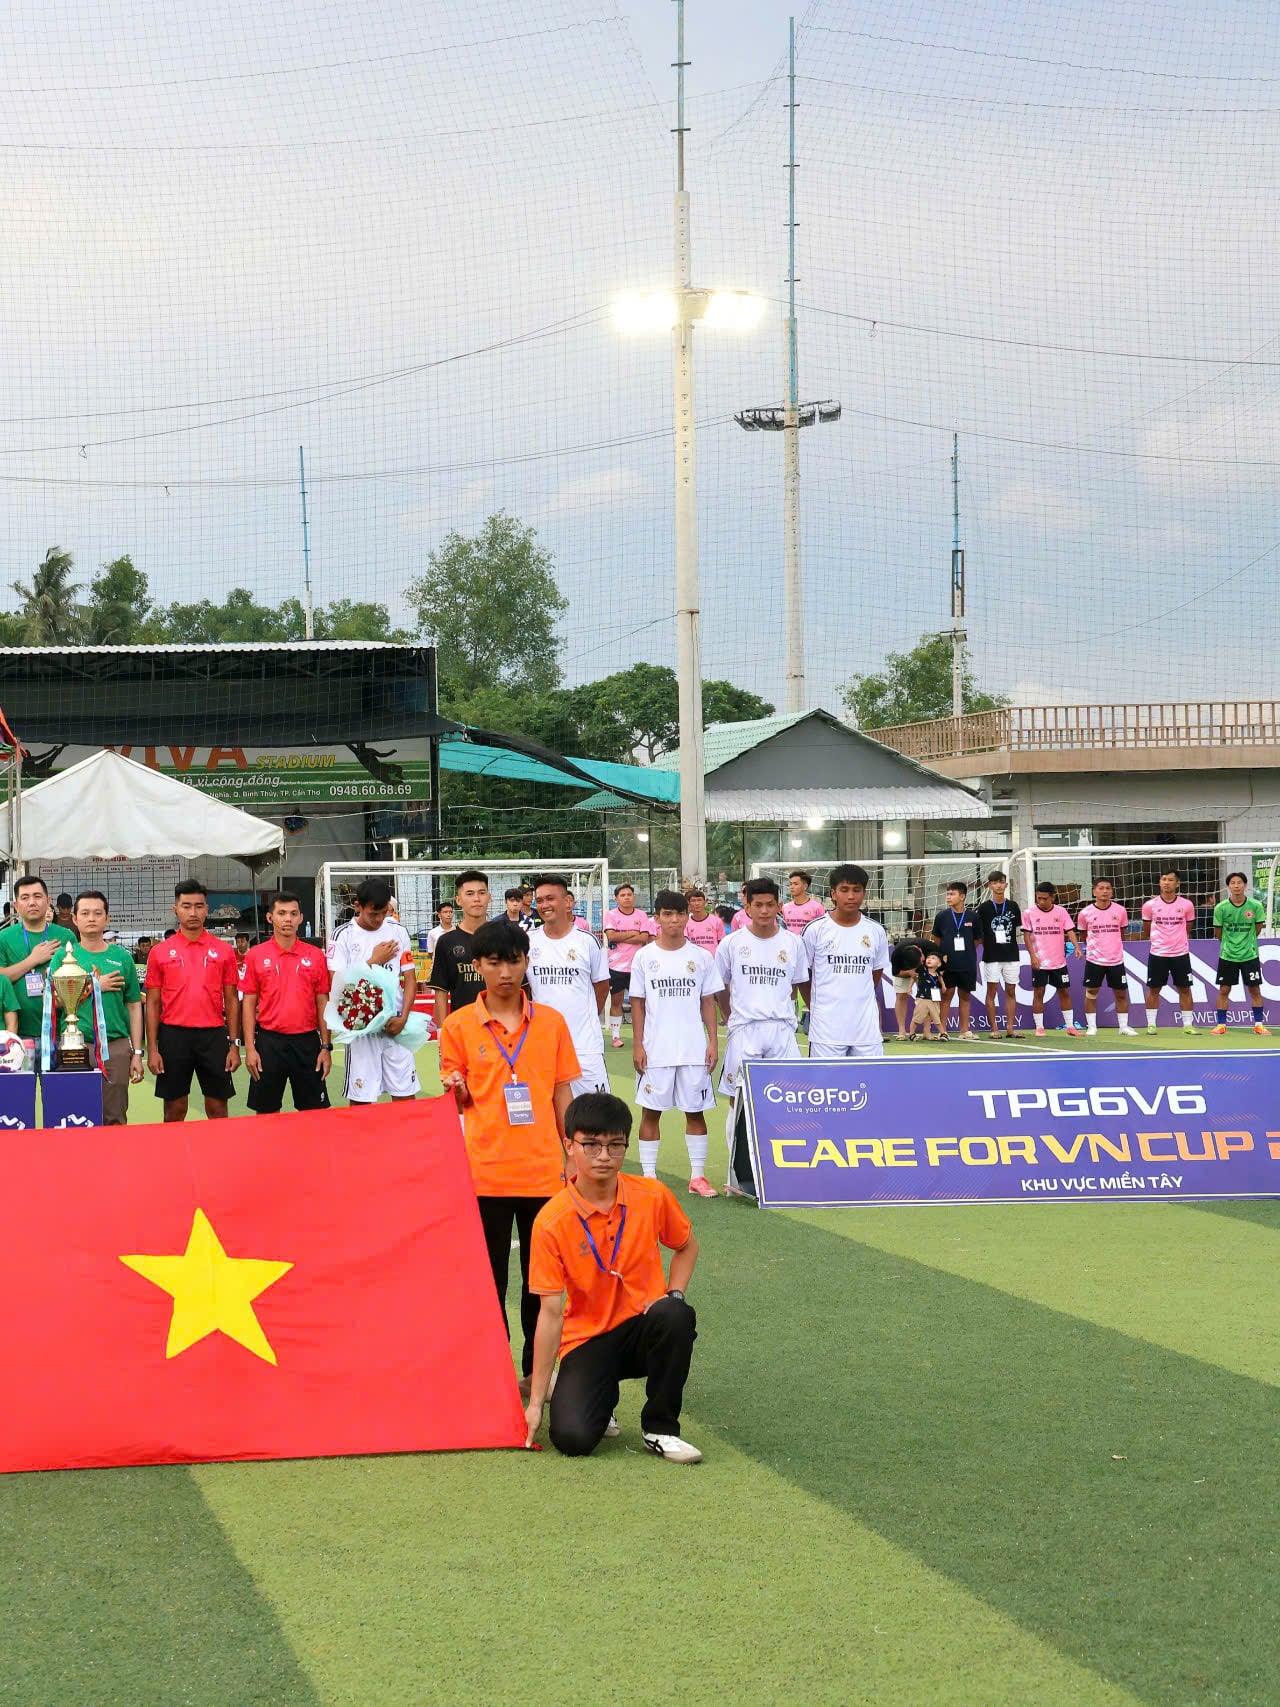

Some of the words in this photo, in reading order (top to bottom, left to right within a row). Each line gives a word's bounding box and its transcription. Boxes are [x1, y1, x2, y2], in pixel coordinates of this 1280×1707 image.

[256, 754, 336, 769] STADIUM
[198, 776, 209, 787] vì
[213, 776, 243, 788] cộng
[248, 774, 281, 787] đồng
[329, 784, 412, 796] 0948.60.68.69
[827, 953, 871, 965] Emirates
[533, 964, 580, 976] Emirates
[741, 964, 787, 977] Emirates
[843, 965, 866, 974] BETTER
[549, 976, 573, 985] BETTER
[759, 976, 779, 986] BETTER
[1249, 971, 1260, 981] 24
[651, 976, 696, 990] Emirates
[668, 988, 691, 997] BETTER
[968, 1085, 1208, 1119] TPG6V6
[770, 1137, 919, 1169] CARE
[923, 1135, 1039, 1167] FOR
[1040, 1132, 1132, 1164] VN
[1136, 1131, 1255, 1162] CUP
[1021, 1177, 1058, 1192] KHU
[1061, 1175, 1096, 1192] VỰC
[1099, 1170, 1146, 1190] MIỀN
[1147, 1172, 1183, 1189] TÂY
